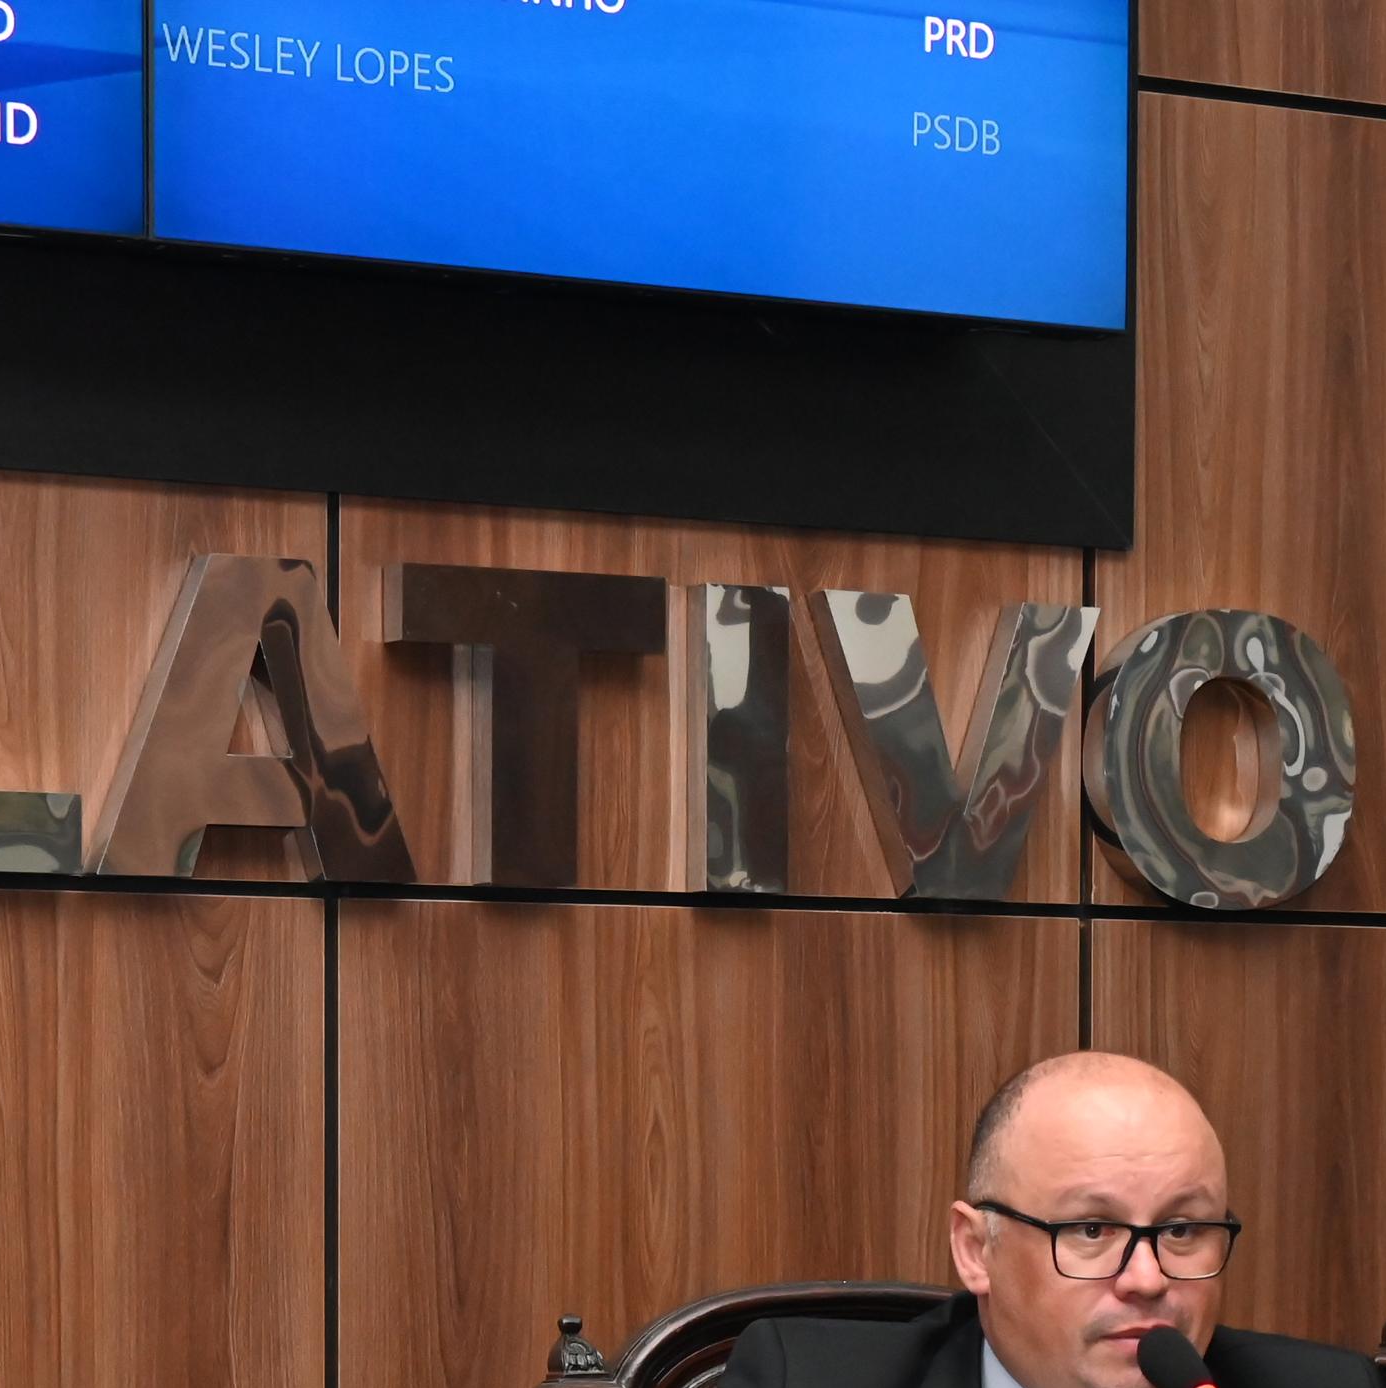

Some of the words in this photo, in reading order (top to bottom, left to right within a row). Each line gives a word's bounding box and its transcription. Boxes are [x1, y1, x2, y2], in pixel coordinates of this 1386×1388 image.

[162, 23, 321, 78] WESLEY
[336, 43, 455, 93] LOPES
[924, 16, 995, 59] PRD
[913, 111, 1001, 156] PSDB
